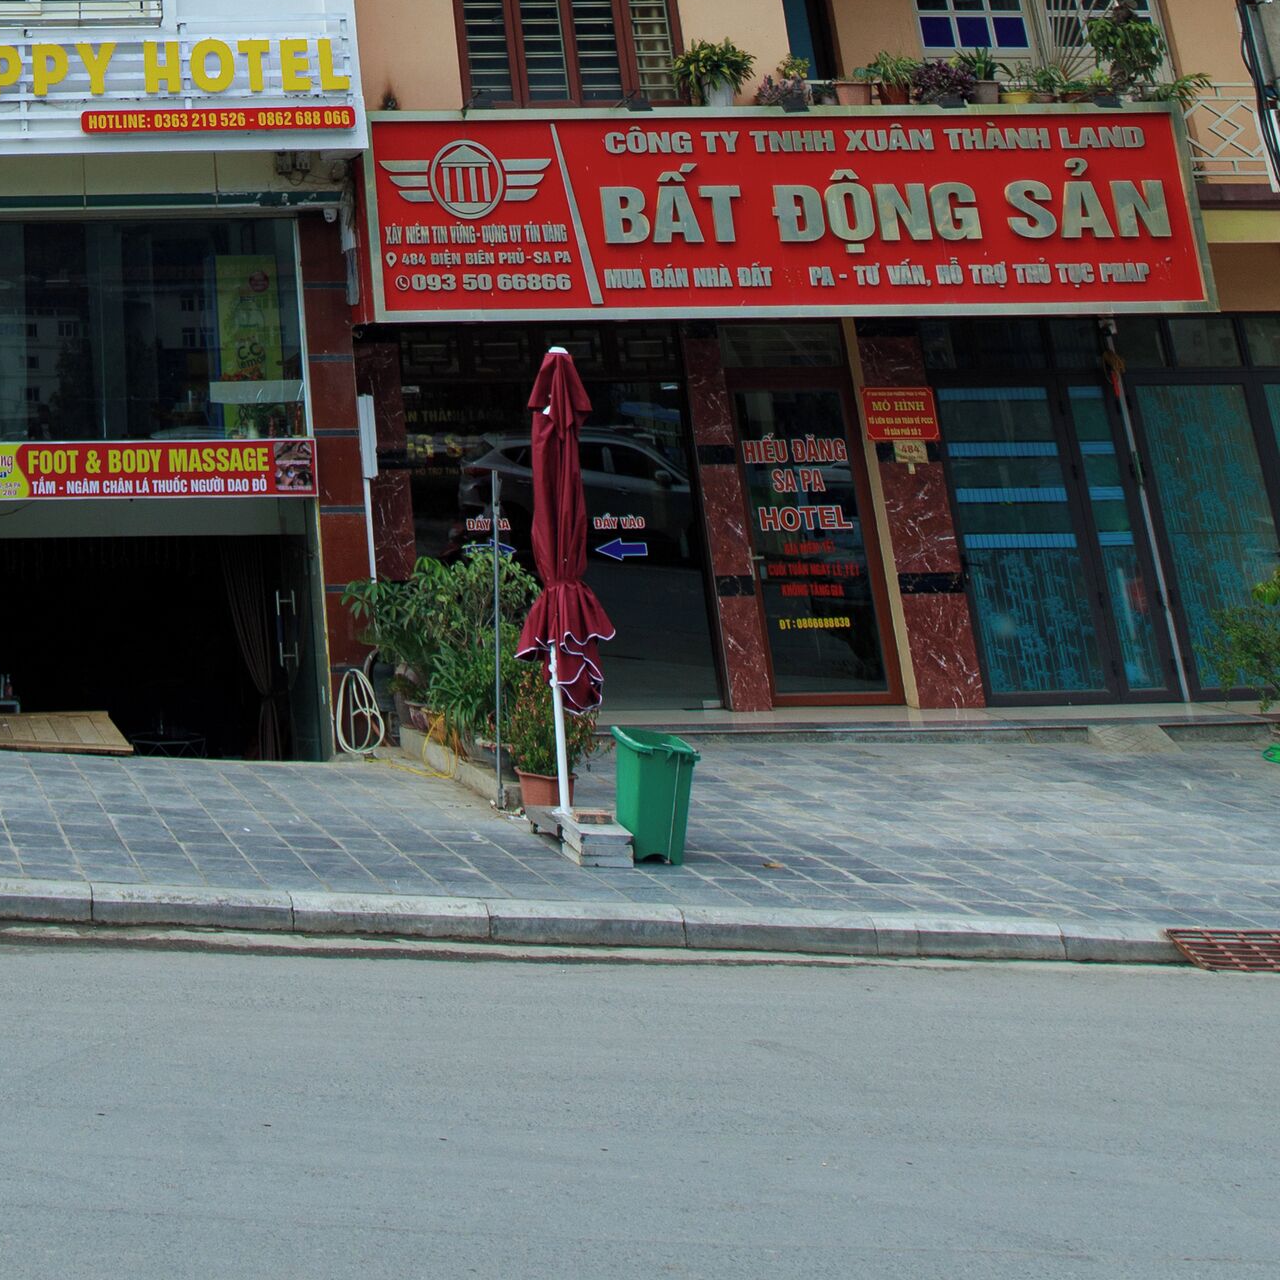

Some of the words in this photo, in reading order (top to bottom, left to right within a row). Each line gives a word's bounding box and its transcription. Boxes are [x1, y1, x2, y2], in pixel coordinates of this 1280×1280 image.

[143, 38, 350, 93] HOTEL
[88, 113, 151, 130] HOTLINE:
[154, 112, 188, 128] 0363
[191, 112, 217, 127] 219
[220, 111, 246, 127] 526
[257, 111, 292, 127] 0862
[295, 111, 321, 126] 688
[323, 110, 350, 125] 066
[604, 126, 692, 155] CÔNG
[700, 131, 739, 154] TY
[750, 129, 836, 153] TNHH
[844, 124, 934, 153] XUÂN
[944, 122, 1051, 151] THÀNH
[1059, 126, 1146, 150] LAND
[599, 162, 741, 244] BẤT
[772, 168, 983, 254] ĐỘNG
[1004, 157, 1173, 242] SẢN
[385, 223, 402, 244] XÂY
[431, 225, 448, 244] TIN
[509, 224, 522, 243] UY
[524, 221, 541, 242] TÍN
[541, 221, 568, 242] VÀNG
[401, 252, 427, 265] 484
[431, 249, 461, 268] ĐIỆN
[465, 249, 495, 265] BIÊN
[499, 247, 525, 264] PHỦ
[533, 251, 552, 264] SA
[554, 251, 572, 263] PA
[411, 274, 457, 291] 093
[462, 274, 493, 291] 50
[497, 273, 572, 291] 66866
[603, 268, 647, 289] MUA
[649, 263, 689, 288] BÁN
[693, 263, 733, 288] NHÀ
[737, 261, 773, 287] ĐẤT
[808, 266, 835, 287] PA
[853, 262, 881, 286] TƯ
[935, 256, 964, 285] HỖ
[968, 261, 1007, 288] TRỢ
[1012, 257, 1052, 284] THỦ
[1055, 263, 1095, 288] TỤC
[27, 450, 79, 474] FOOT
[85, 450, 101, 473] &
[108, 449, 162, 473] BODY
[168, 447, 270, 472] MASSAGE
[742, 433, 788, 463] HIẾU
[791, 434, 848, 462] ĐĂNG
[66, 478, 100, 493] NGÂM
[102, 477, 133, 493] CHÂN
[135, 477, 149, 493] LÁ
[152, 475, 187, 493] THUỐC
[190, 476, 225, 493] NGƯỜI
[227, 478, 249, 492] DAO
[252, 474, 268, 491] ĐỎ
[772, 469, 798, 492] SA
[799, 468, 826, 492] PA
[758, 505, 853, 531] HOTEL
